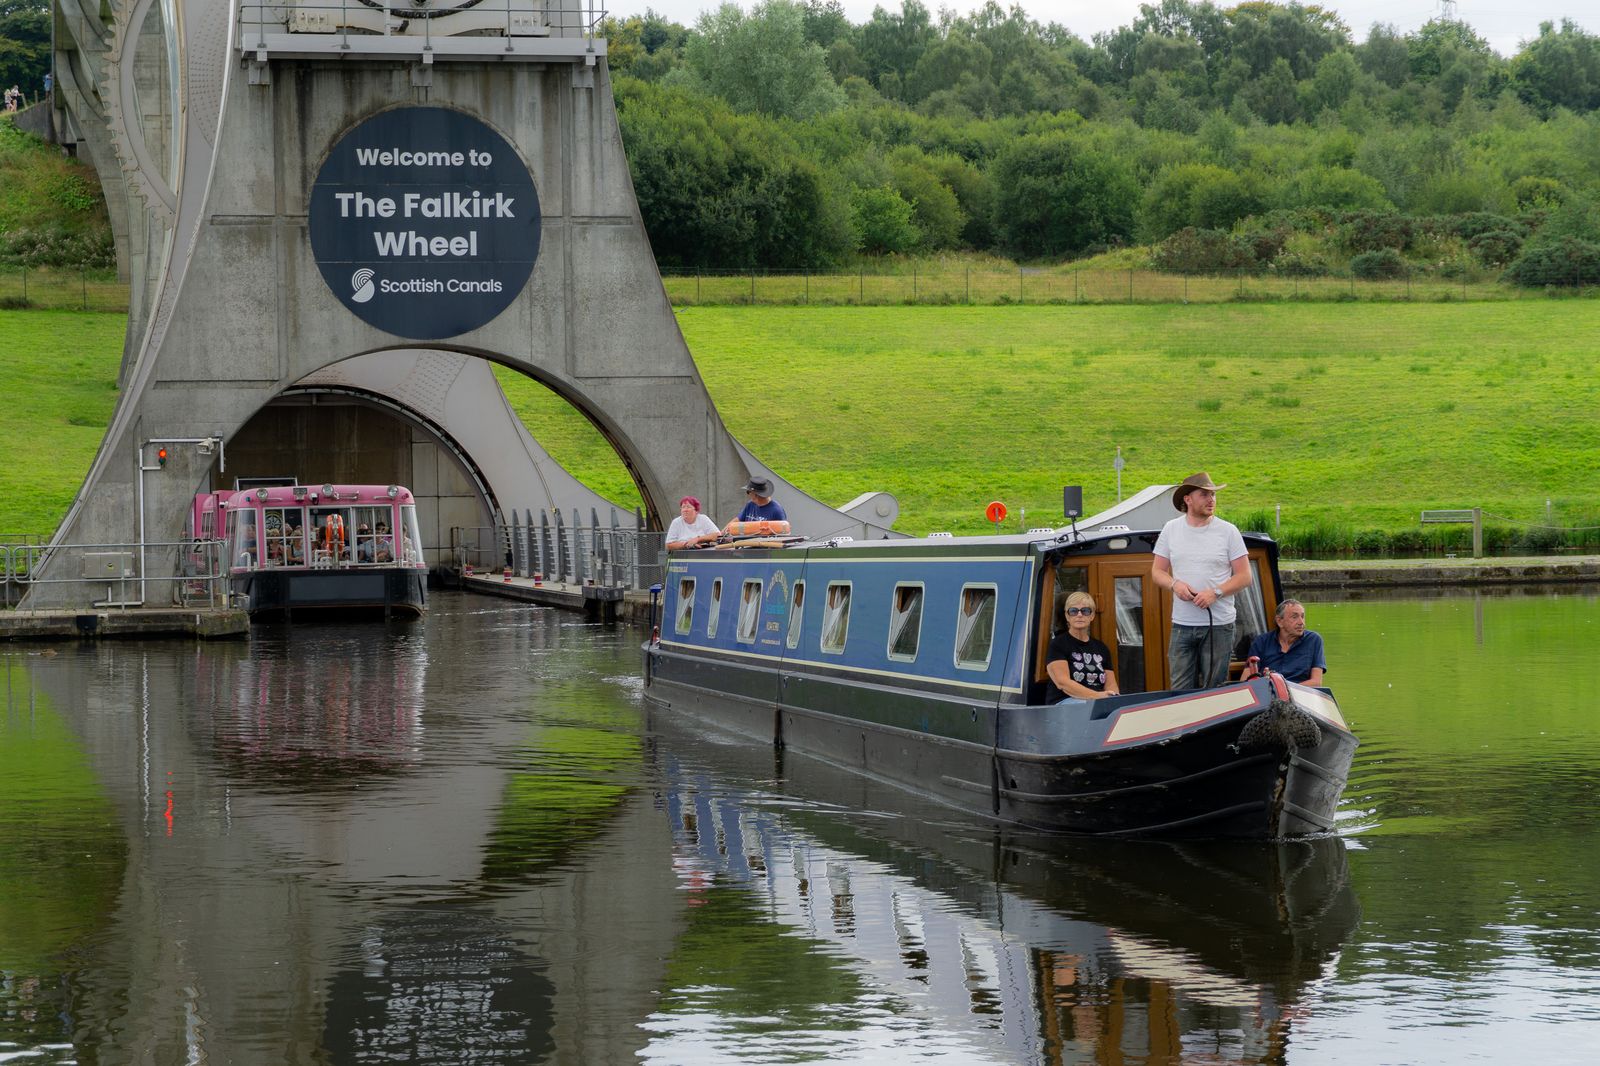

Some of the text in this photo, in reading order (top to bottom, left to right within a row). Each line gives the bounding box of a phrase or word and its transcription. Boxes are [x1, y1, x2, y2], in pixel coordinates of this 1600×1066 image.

[356, 147, 493, 167] Welcome to
[335, 190, 516, 218] The Falkirk
[373, 230, 478, 257] Wheel
[380, 277, 503, 293] Scottish Canals
